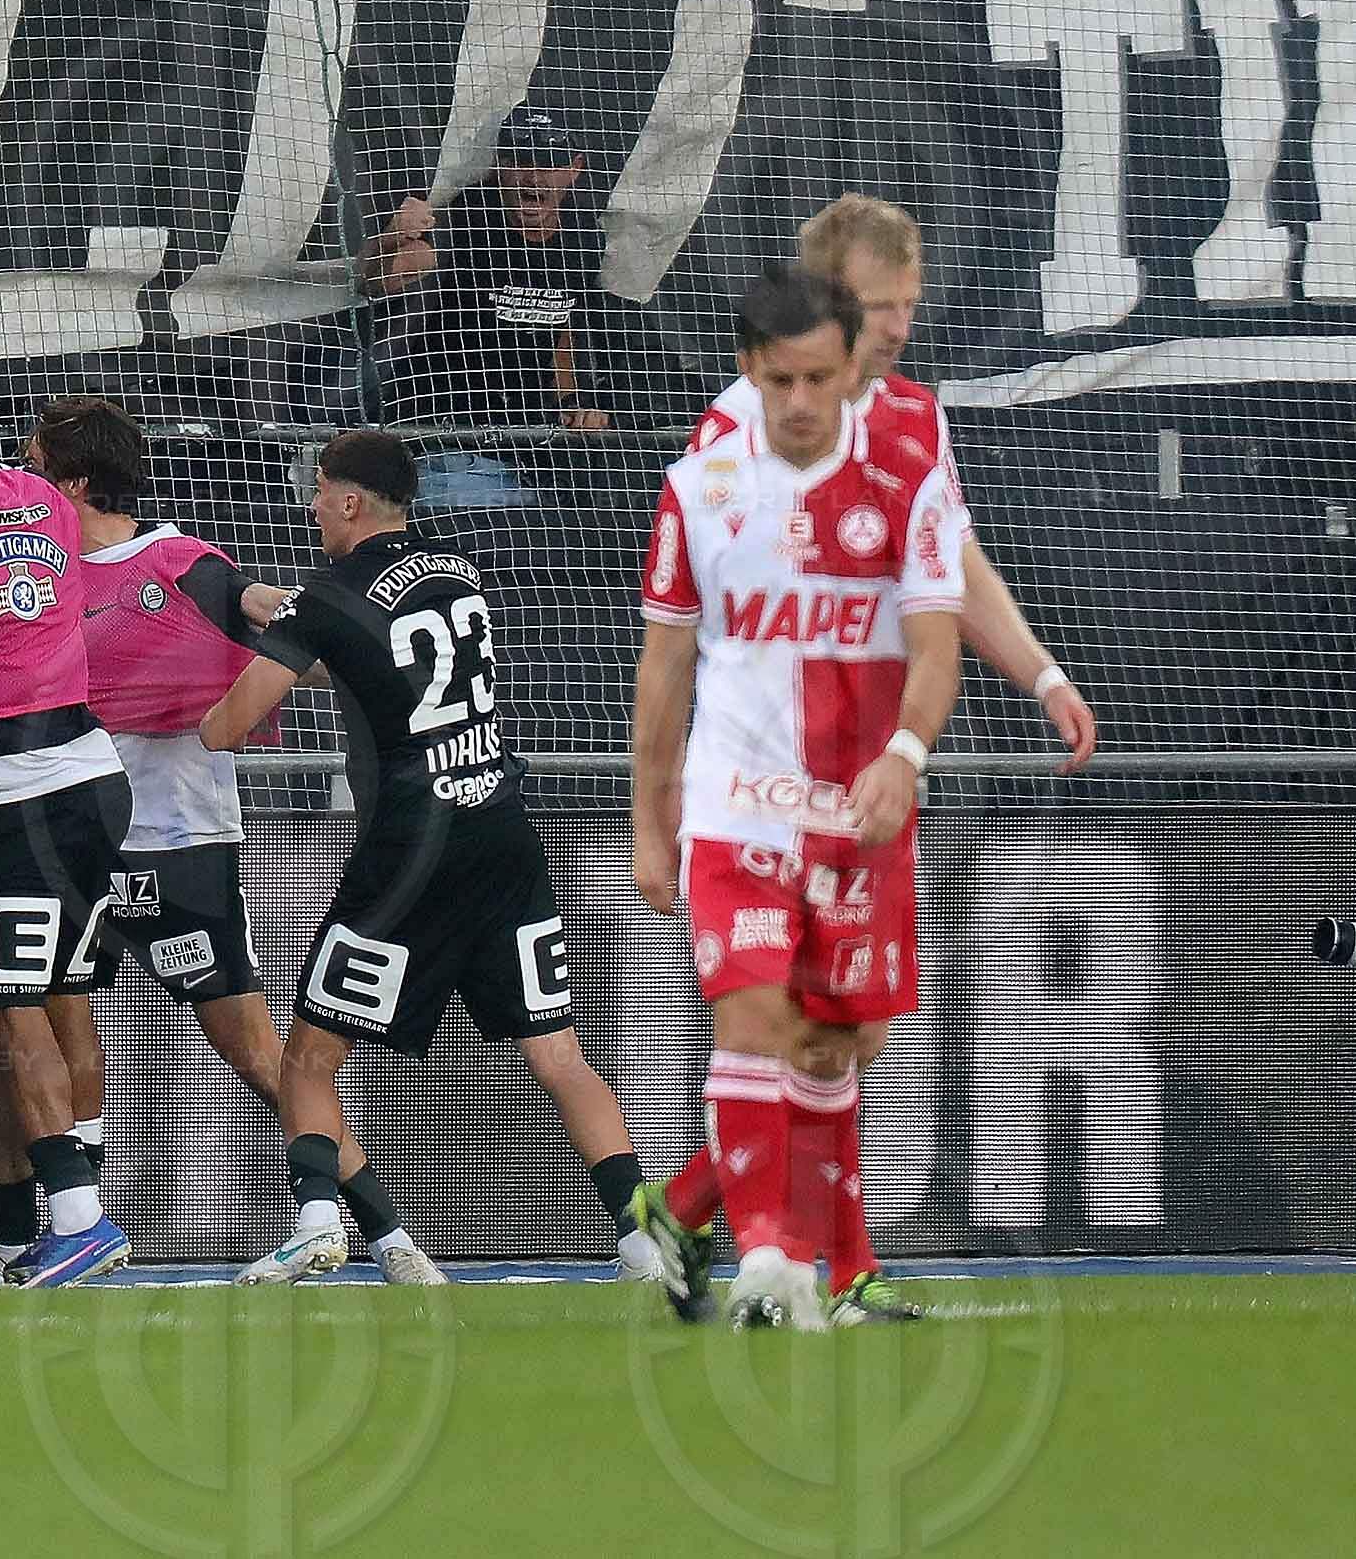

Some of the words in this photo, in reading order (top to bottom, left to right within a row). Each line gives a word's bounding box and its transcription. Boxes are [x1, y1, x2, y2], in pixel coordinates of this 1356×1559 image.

[378, 556, 481, 603] PUNTIGAMER
[722, 589, 880, 645] MAPEI
[390, 594, 496, 735] 23
[112, 904, 161, 919] HOLDING
[159, 948, 208, 971] ZEITUNG
[160, 938, 202, 958] KLEINE
[304, 999, 336, 1020] ENERGIE
[337, 1011, 388, 1035] STEIERMARK
[529, 1008, 563, 1023] ENERGIE
